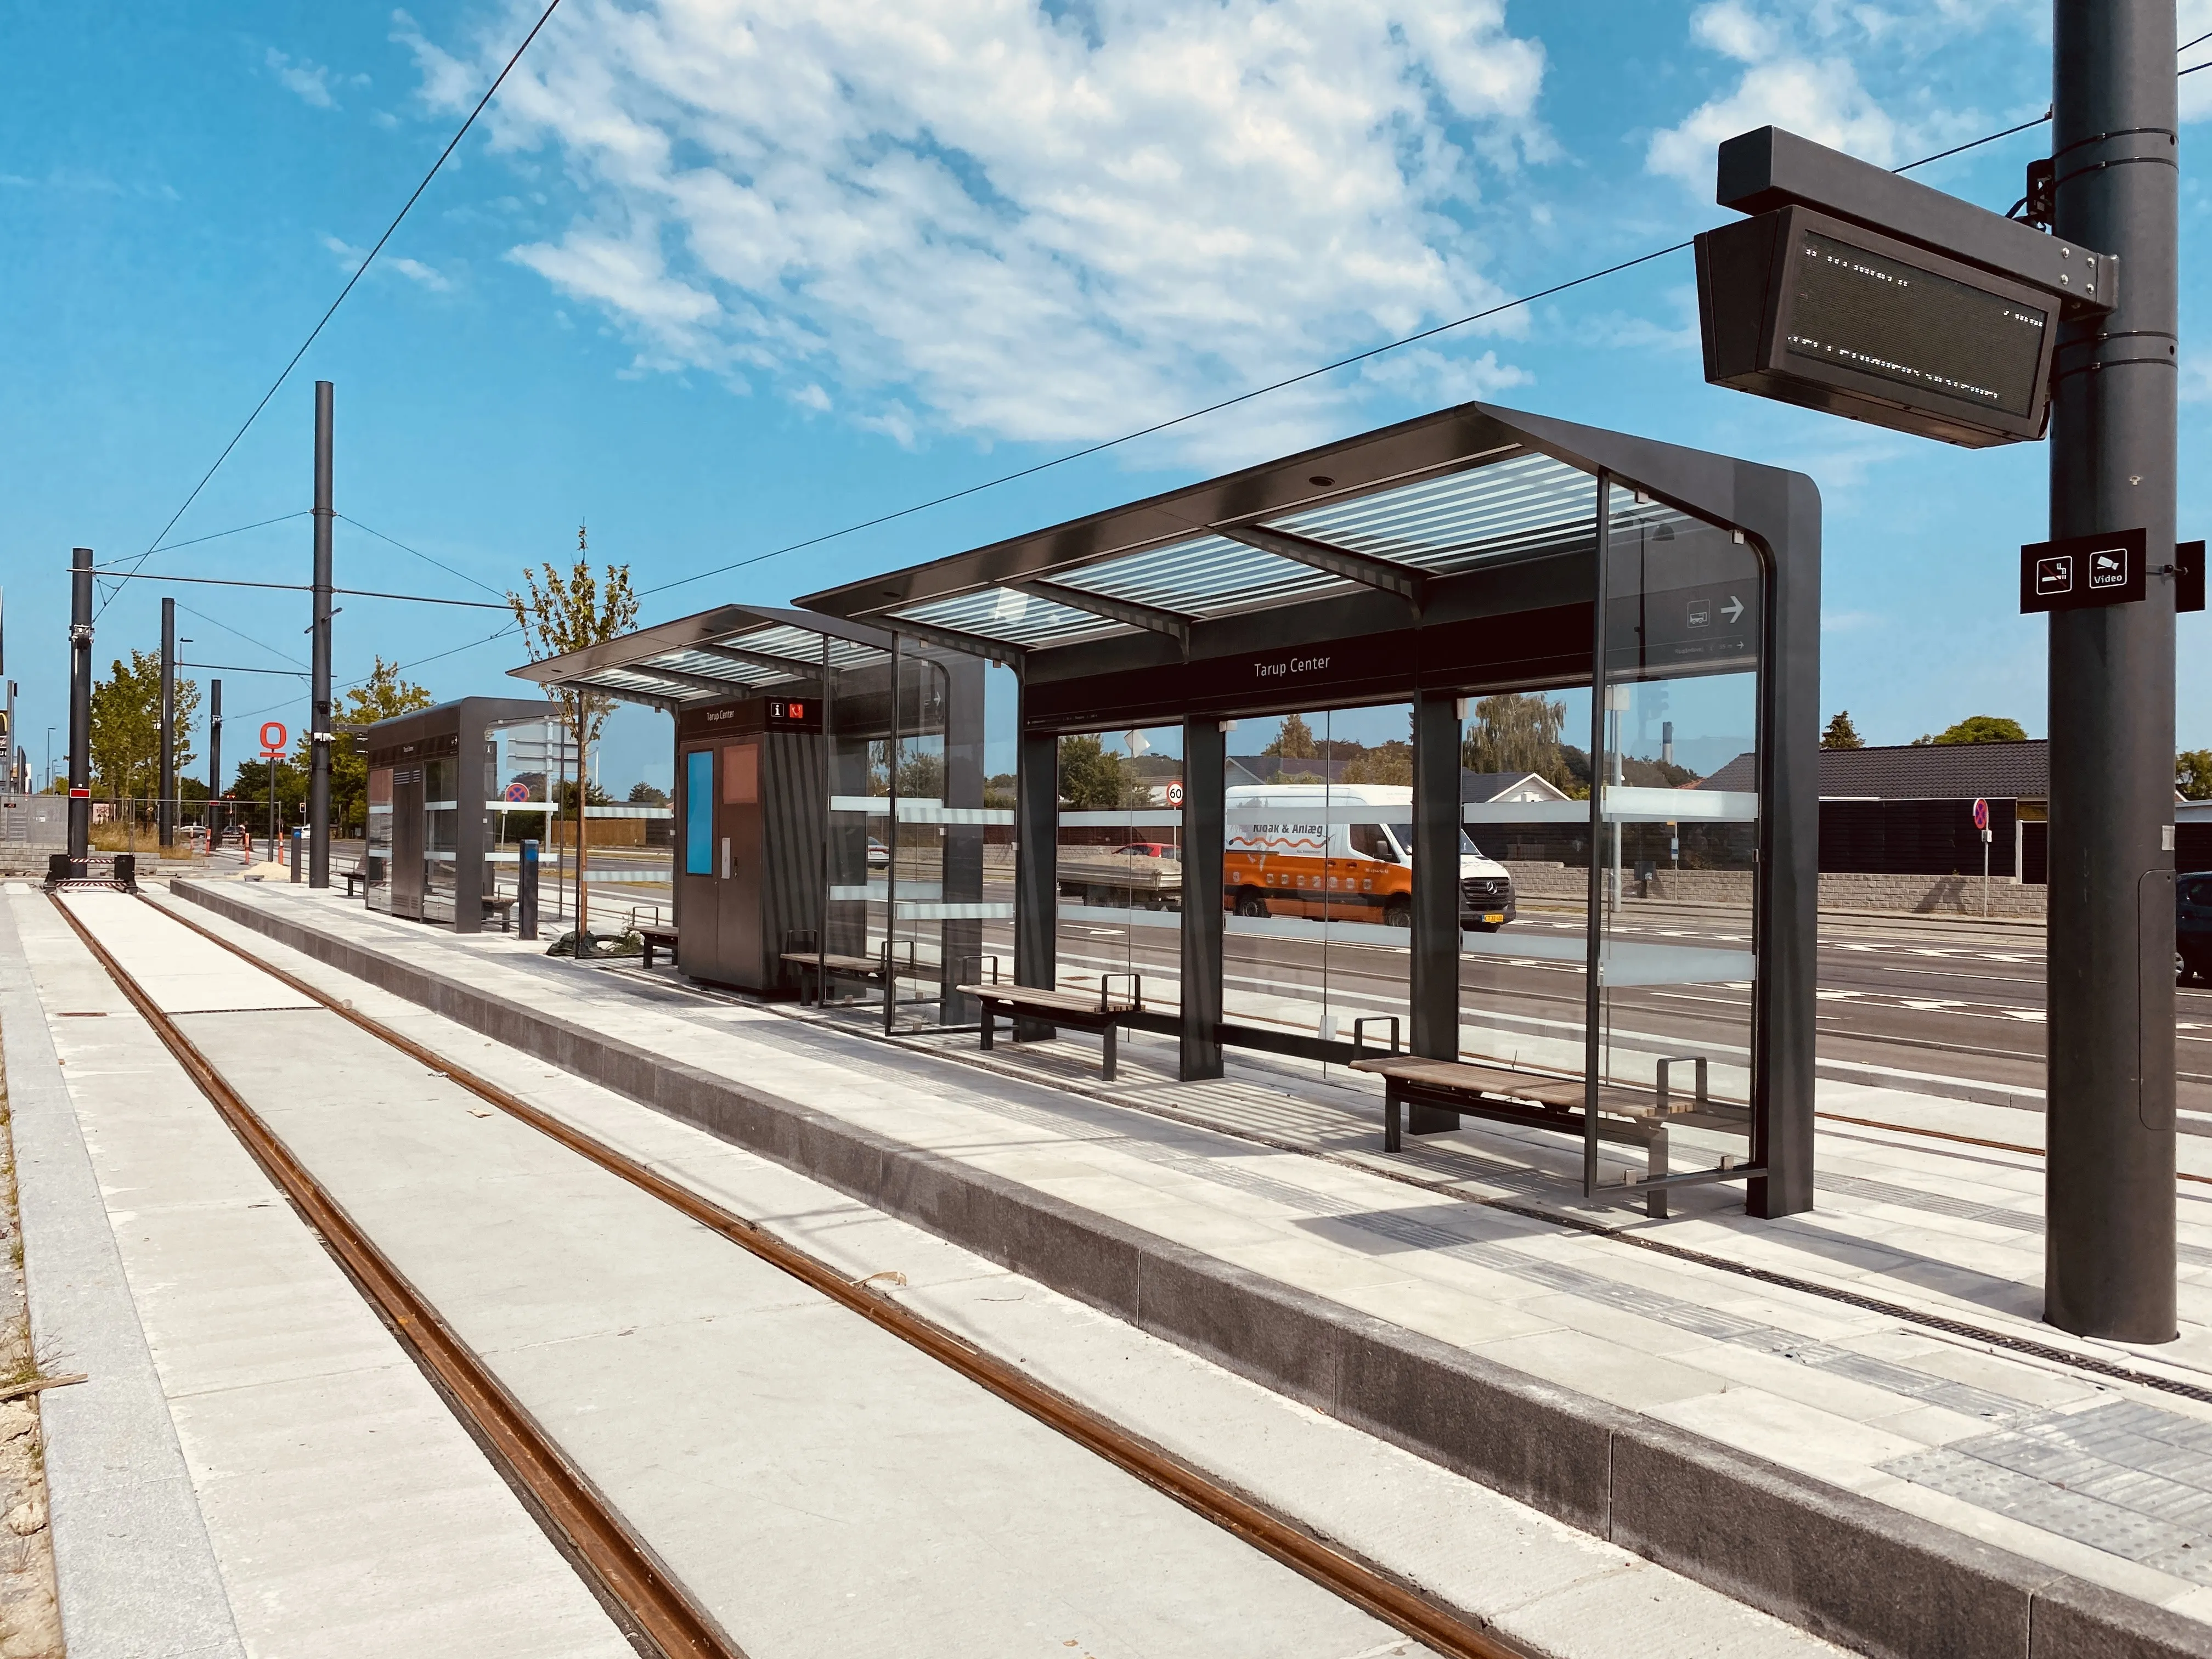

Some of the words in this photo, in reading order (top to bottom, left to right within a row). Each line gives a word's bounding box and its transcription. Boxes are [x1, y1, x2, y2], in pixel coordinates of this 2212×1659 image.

[2094, 574, 2122, 584] Video
[1254, 663, 1286, 677] Tarup
[1290, 657, 1330, 673] Center
[707, 712, 719, 721] Tarup
[720, 710, 735, 719] Center
[1170, 788, 1182, 799] 60
[1282, 825, 1289, 833] &
[1292, 824, 1323, 838] Anlæg
